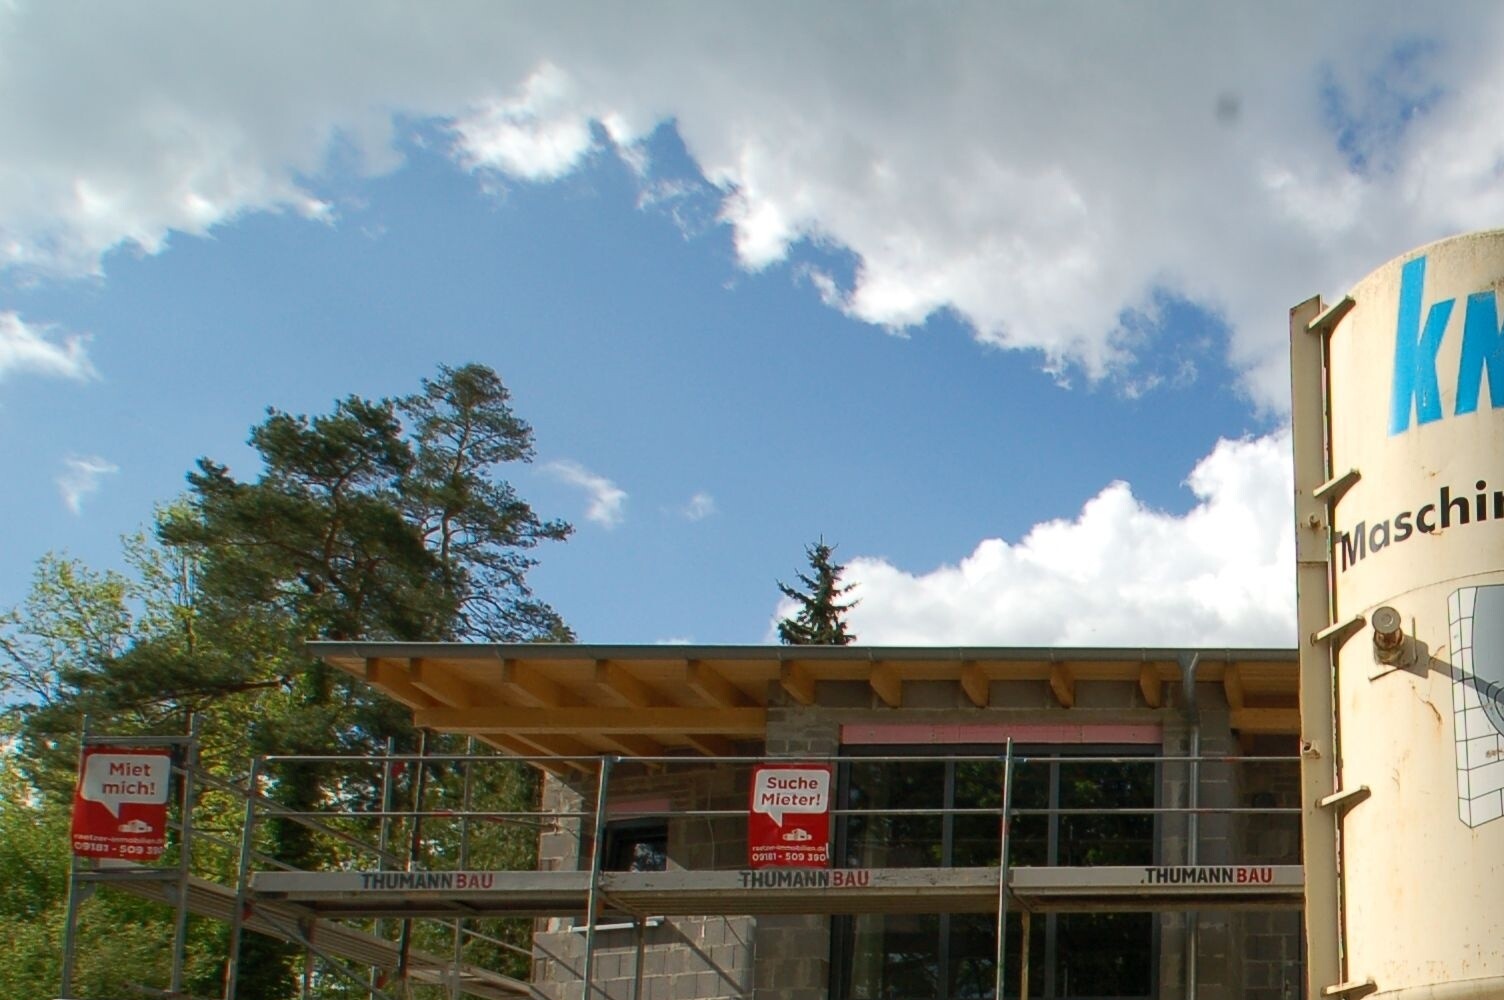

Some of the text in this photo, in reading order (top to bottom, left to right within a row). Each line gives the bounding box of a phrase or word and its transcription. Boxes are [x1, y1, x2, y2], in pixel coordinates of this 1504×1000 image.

[109, 762, 151, 777] Miet
[102, 781, 155, 795] mich!
[767, 776, 818, 790] Suche
[761, 793, 821, 806] Mieter!
